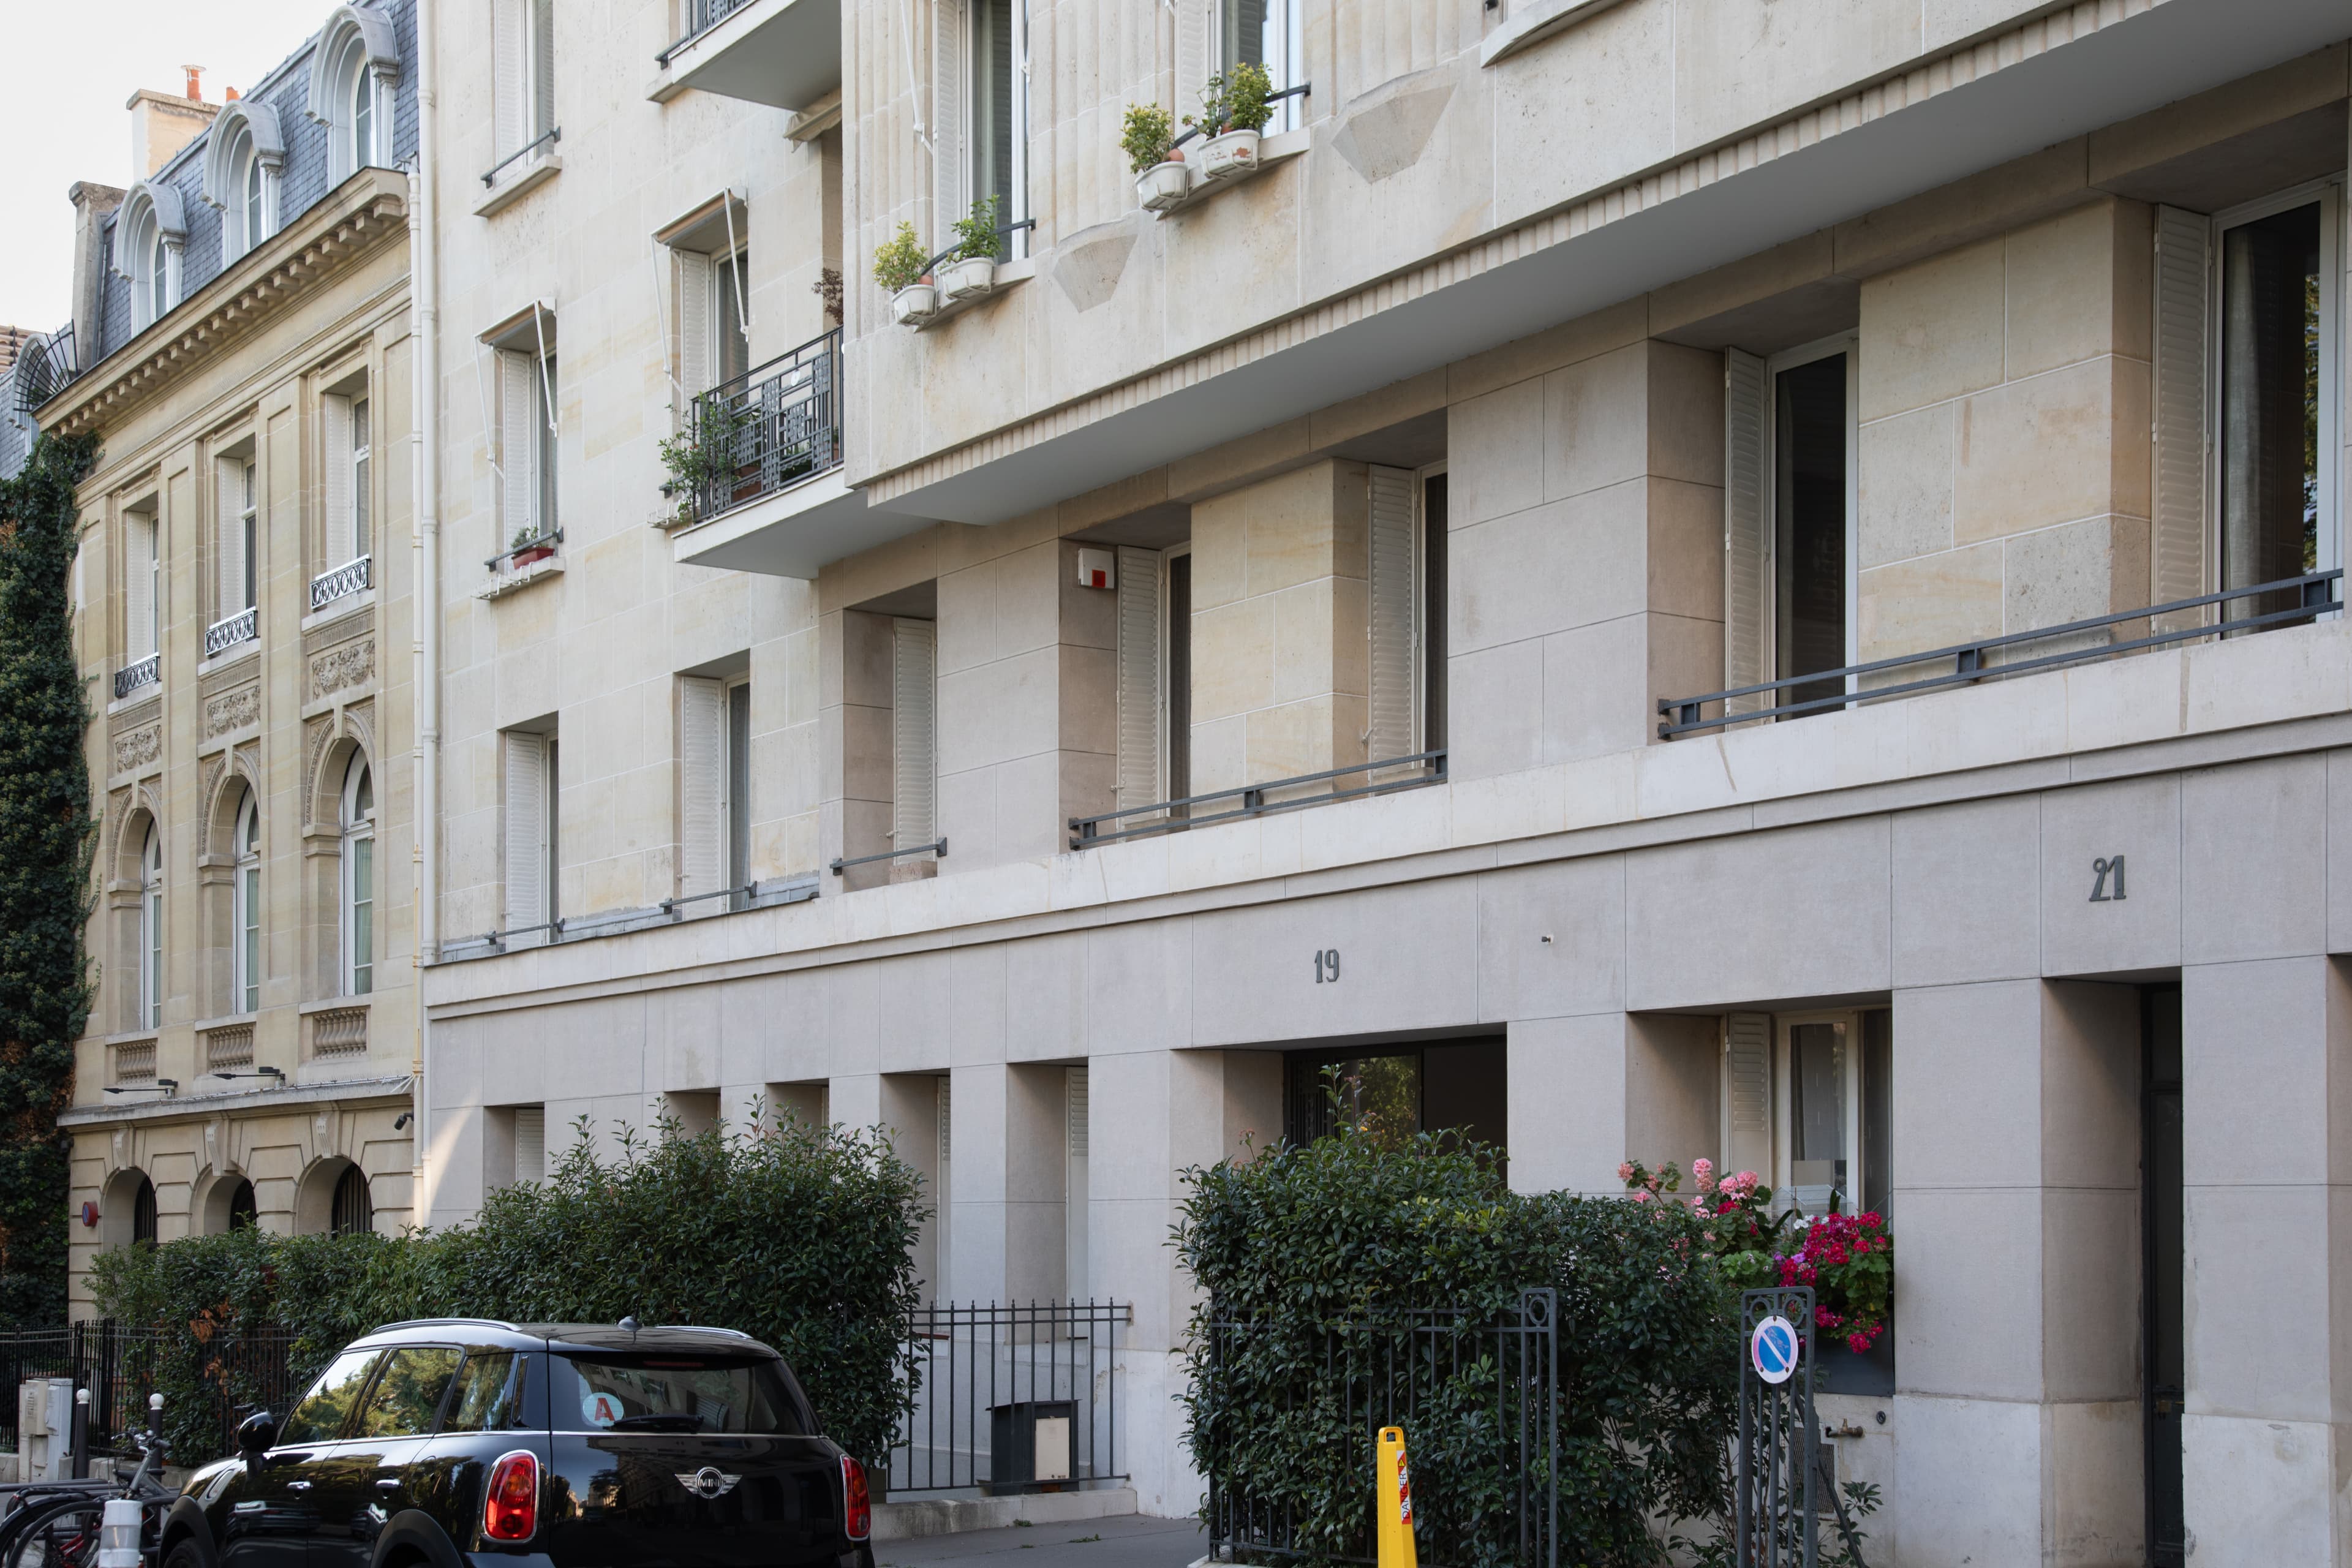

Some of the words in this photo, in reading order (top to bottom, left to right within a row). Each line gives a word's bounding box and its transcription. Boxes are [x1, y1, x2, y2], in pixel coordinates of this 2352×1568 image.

[2089, 855, 2127, 902] 21
[1314, 949, 1339, 983] 19
[594, 1397, 616, 1421] A
[699, 1479, 720, 1487] MINI
[1399, 1473, 1410, 1519] DANGER
